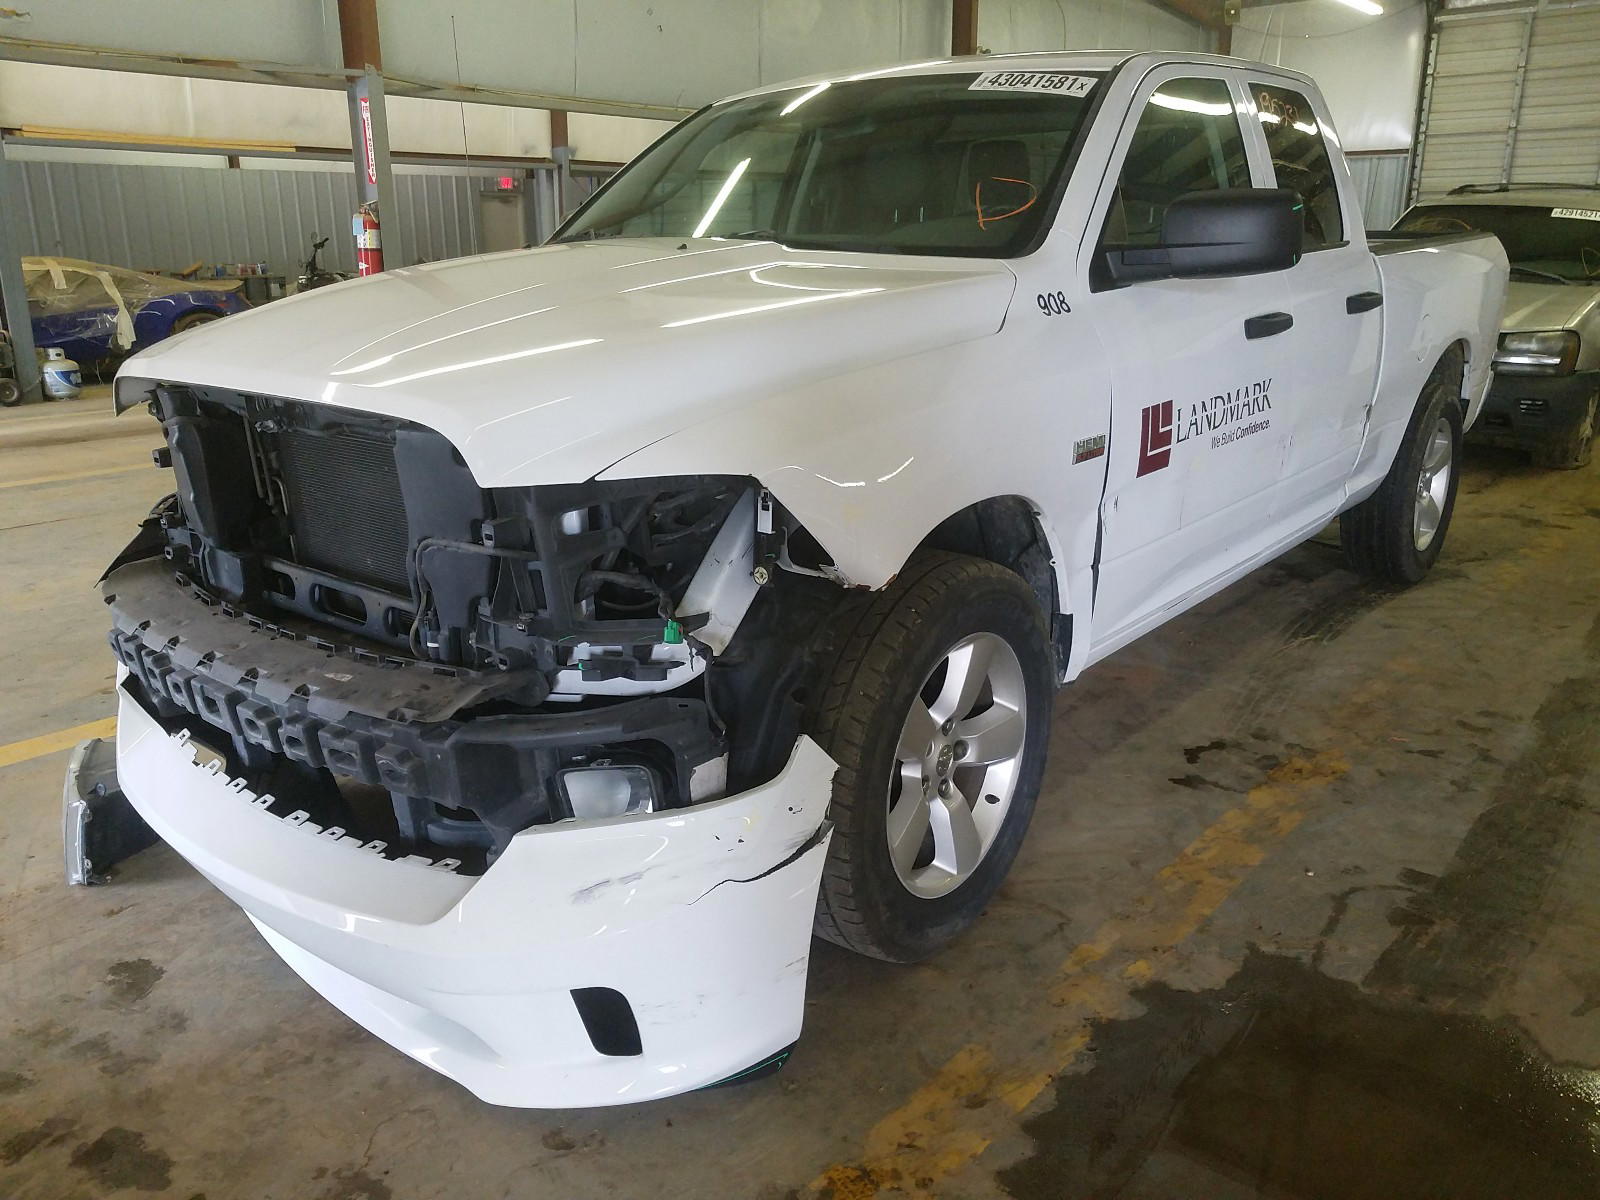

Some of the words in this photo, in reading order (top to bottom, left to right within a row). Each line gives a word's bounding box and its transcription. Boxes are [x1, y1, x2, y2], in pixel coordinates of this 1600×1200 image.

[1036, 290, 1072, 317] 908
[1176, 378, 1272, 444] LANDMARK
[1211, 434, 1221, 450] We
[1220, 430, 1236, 446] Build
